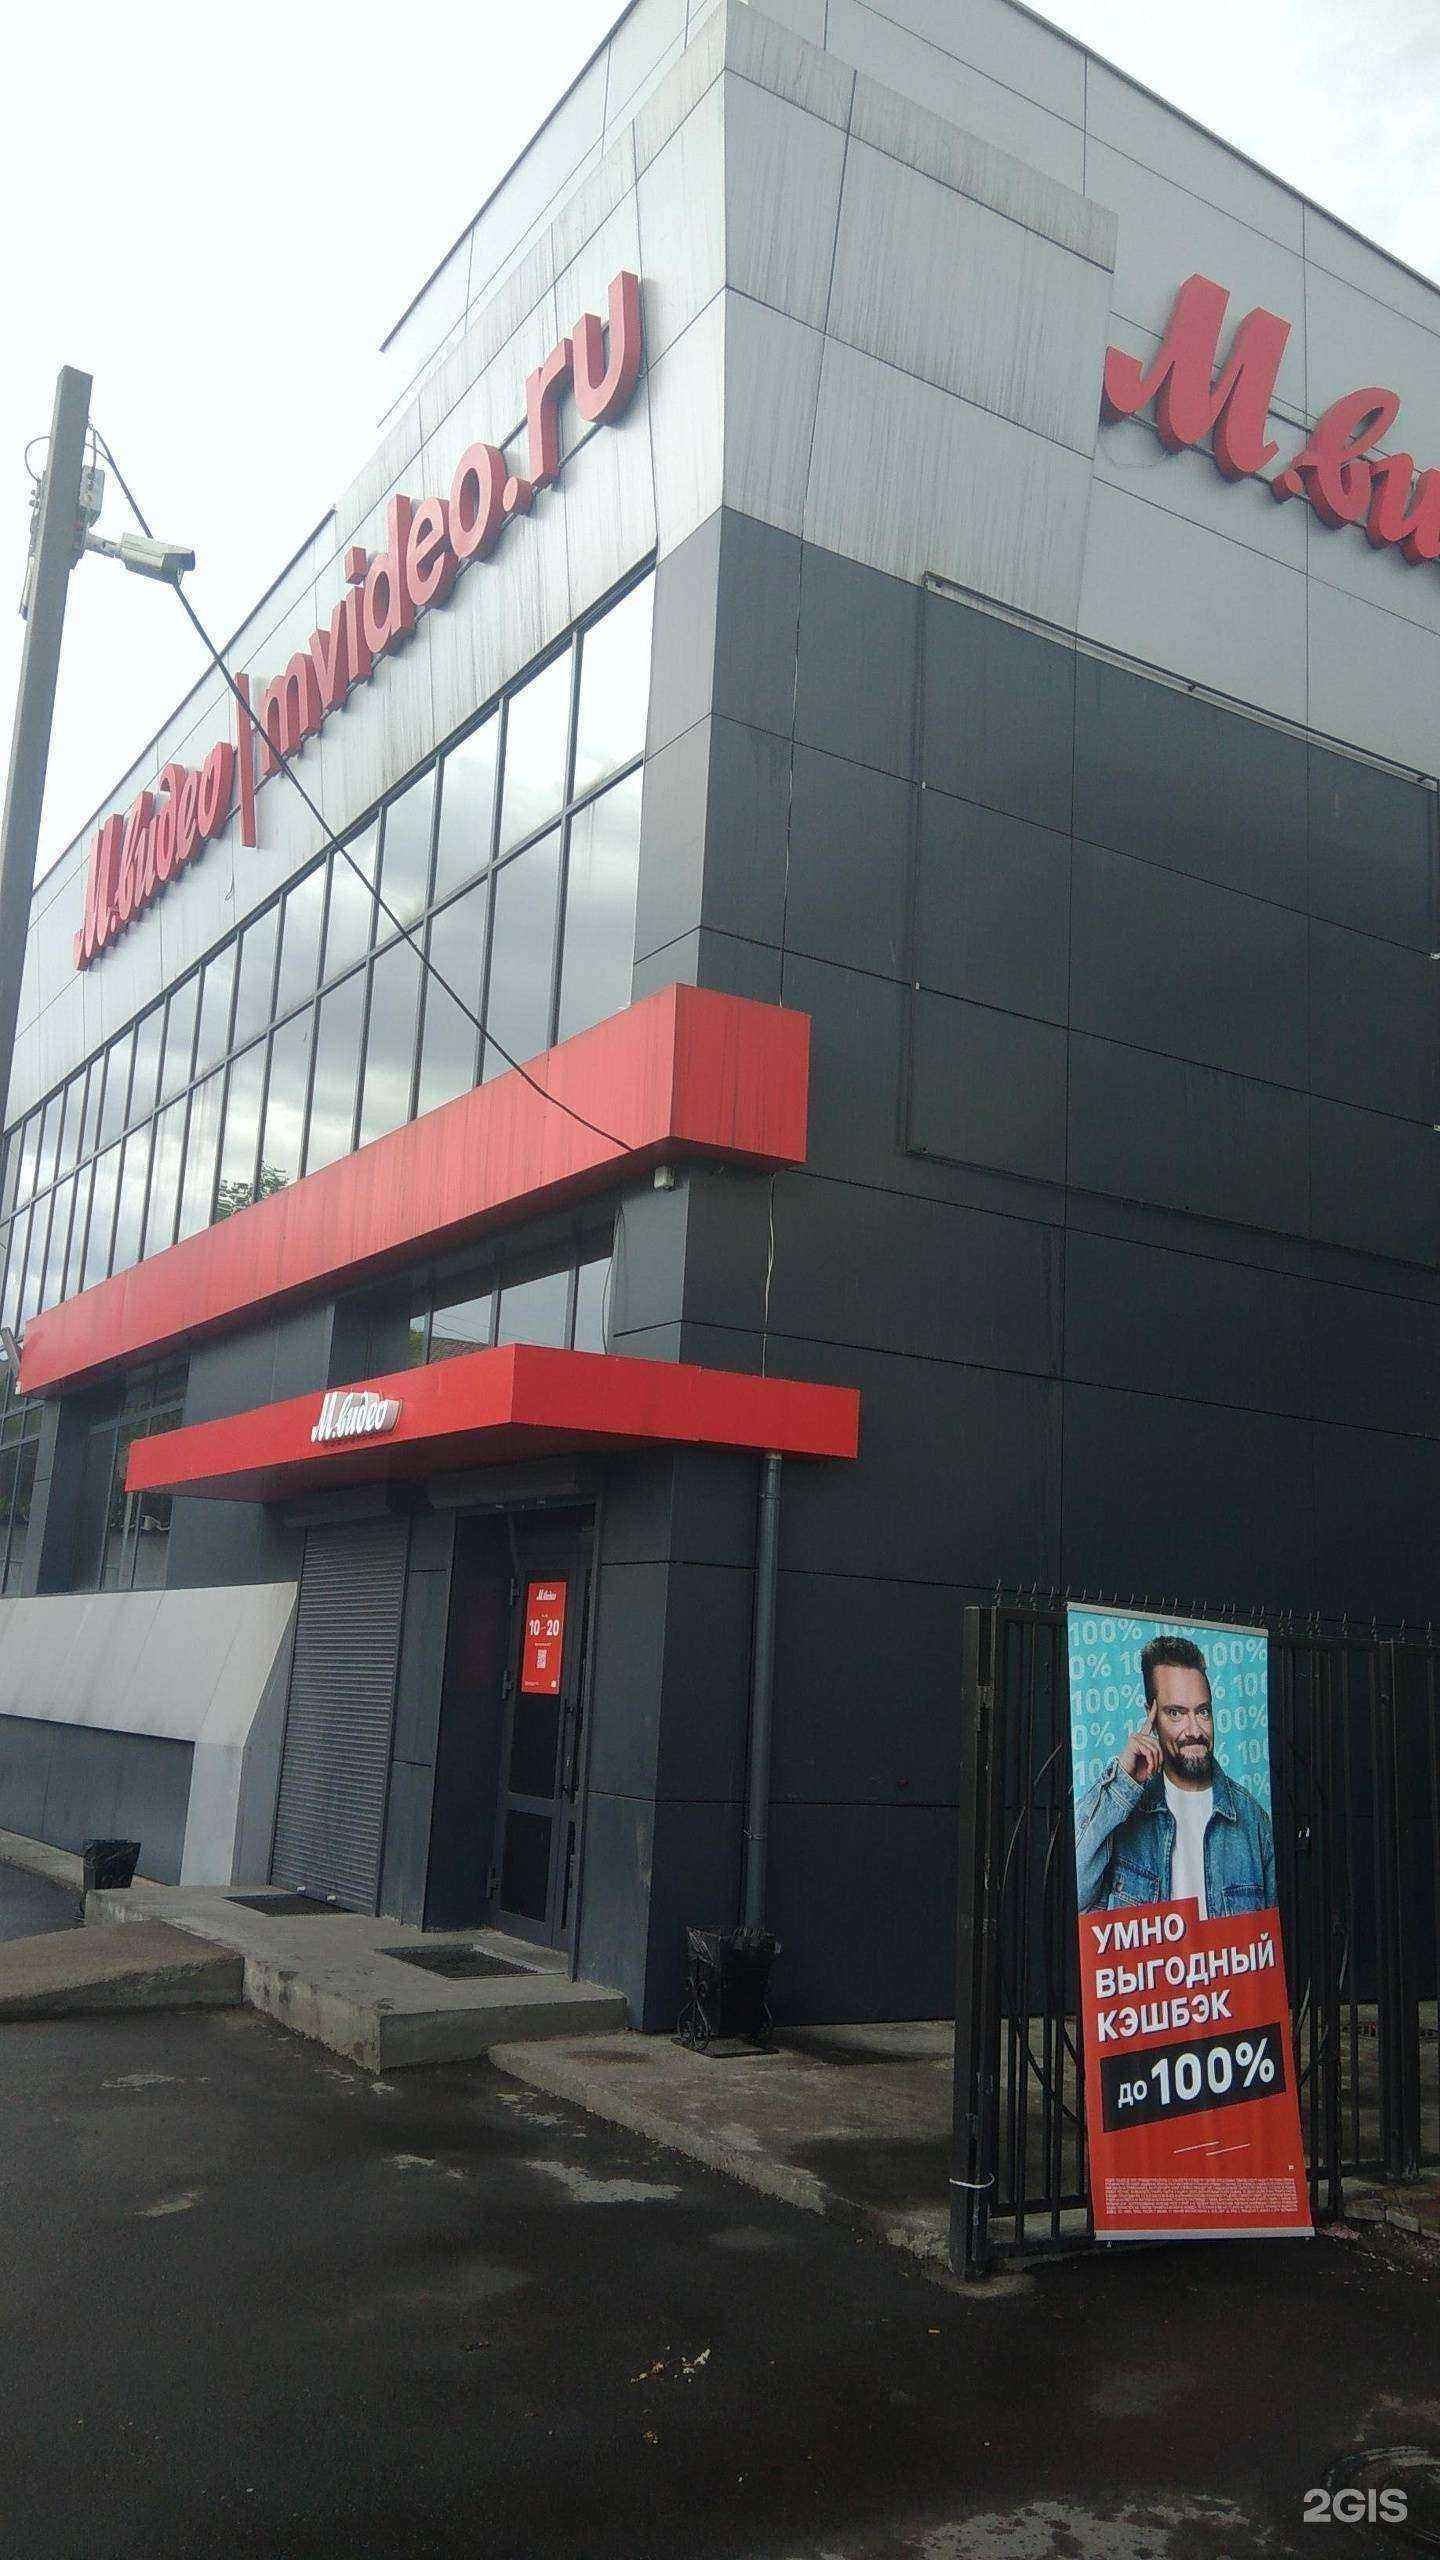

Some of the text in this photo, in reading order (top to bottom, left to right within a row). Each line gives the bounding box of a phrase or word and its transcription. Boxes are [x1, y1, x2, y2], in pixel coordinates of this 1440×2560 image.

[259, 270, 640, 776] mvideo.ru
[1091, 1912, 1185, 1954] УМНО
[1095, 1932, 1276, 1999] ВЫГОДНЫЙ
[1097, 1988, 1233, 2043] КЭШБЭК
[1150, 2037, 1275, 2106] 100%
